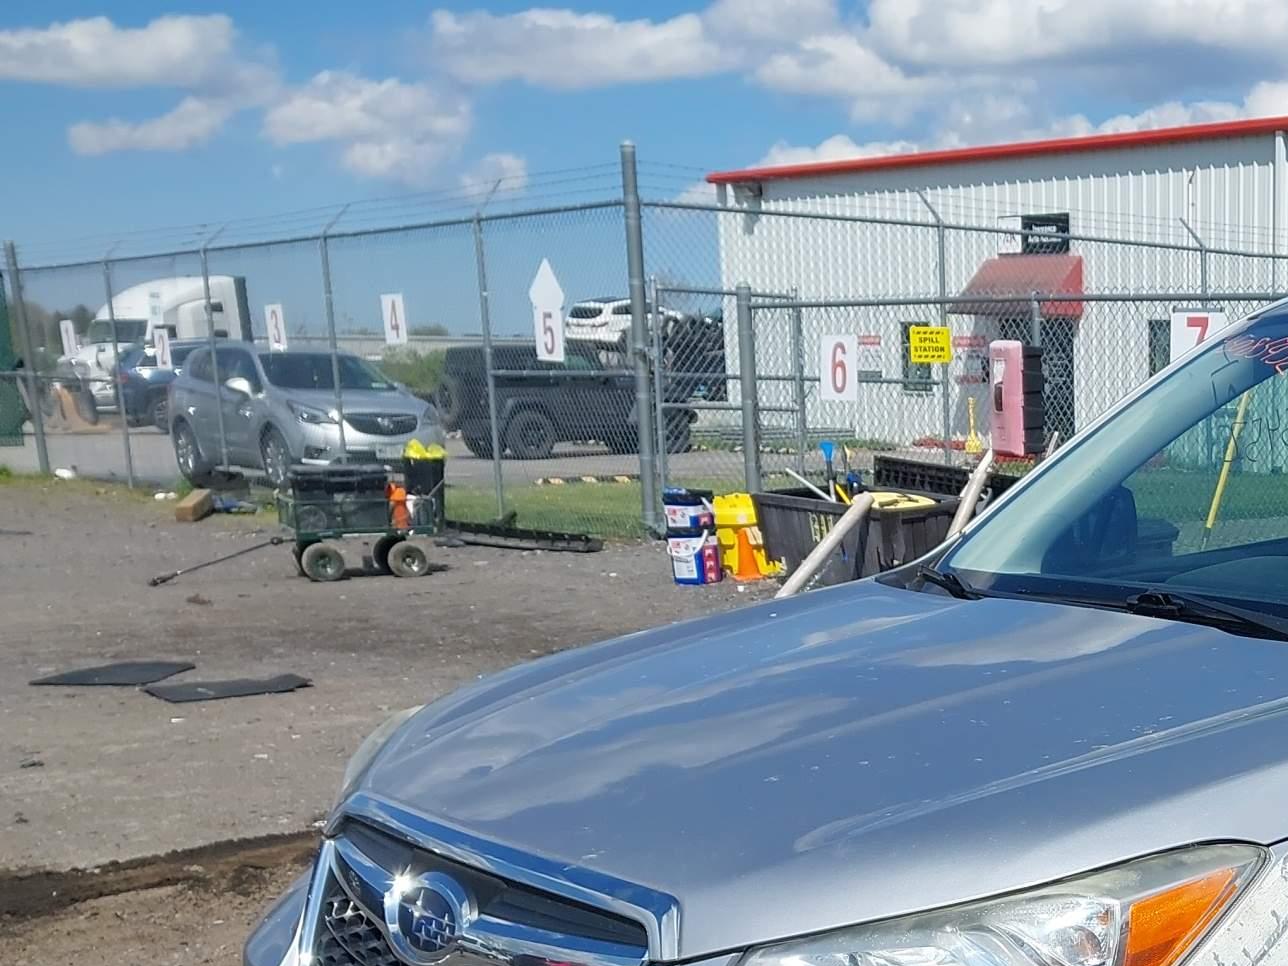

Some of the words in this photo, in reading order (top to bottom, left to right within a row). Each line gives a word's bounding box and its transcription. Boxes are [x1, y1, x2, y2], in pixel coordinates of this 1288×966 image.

[271, 309, 281, 343] 3
[390, 299, 400, 339] 4
[542, 312, 556, 355] 5
[1186, 316, 1209, 346] 7
[158, 334, 167, 365] 2
[913, 345, 946, 353] STATION
[918, 336, 940, 344] SPILL
[831, 341, 847, 394] 6
